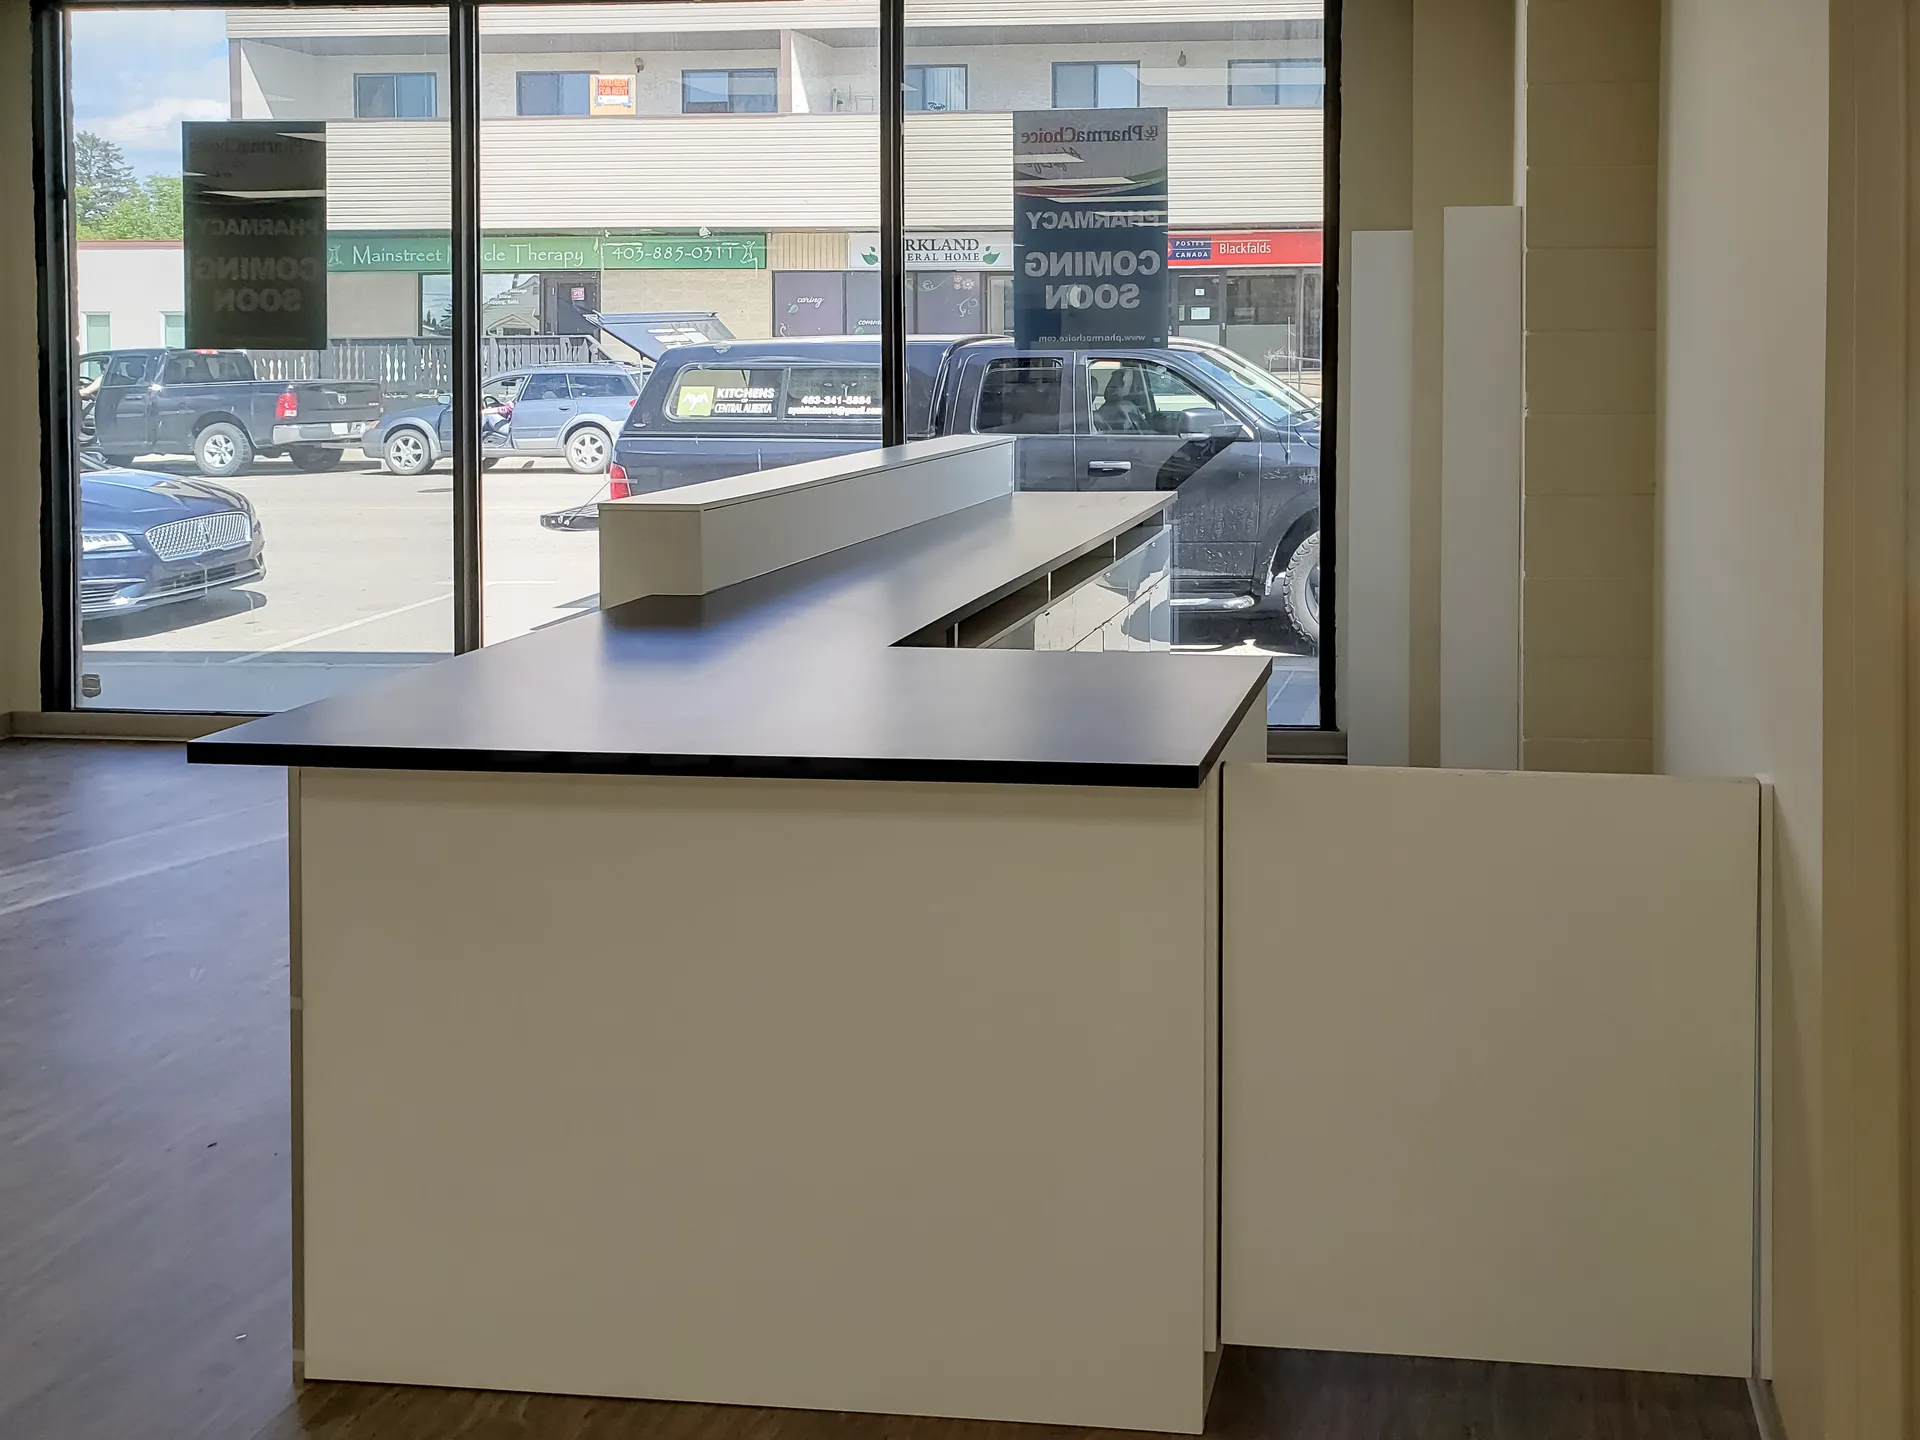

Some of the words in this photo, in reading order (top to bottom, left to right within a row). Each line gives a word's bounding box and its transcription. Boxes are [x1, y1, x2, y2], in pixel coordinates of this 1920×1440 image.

[598, 87, 611, 95] FOR
[611, 87, 628, 95] RENT
[905, 238, 980, 251] RKLAND
[1219, 242, 1272, 254] Blackfalds
[353, 245, 443, 265] Mainstreet
[509, 244, 584, 268] Therapy
[612, 246, 733, 262] 403-885-0311
[944, 253, 980, 261] HOME
[797, 296, 824, 309] caring
[716, 387, 775, 399] KITCHENS
[714, 403, 742, 413] CENTRAL
[742, 403, 772, 413] ALBERTA
